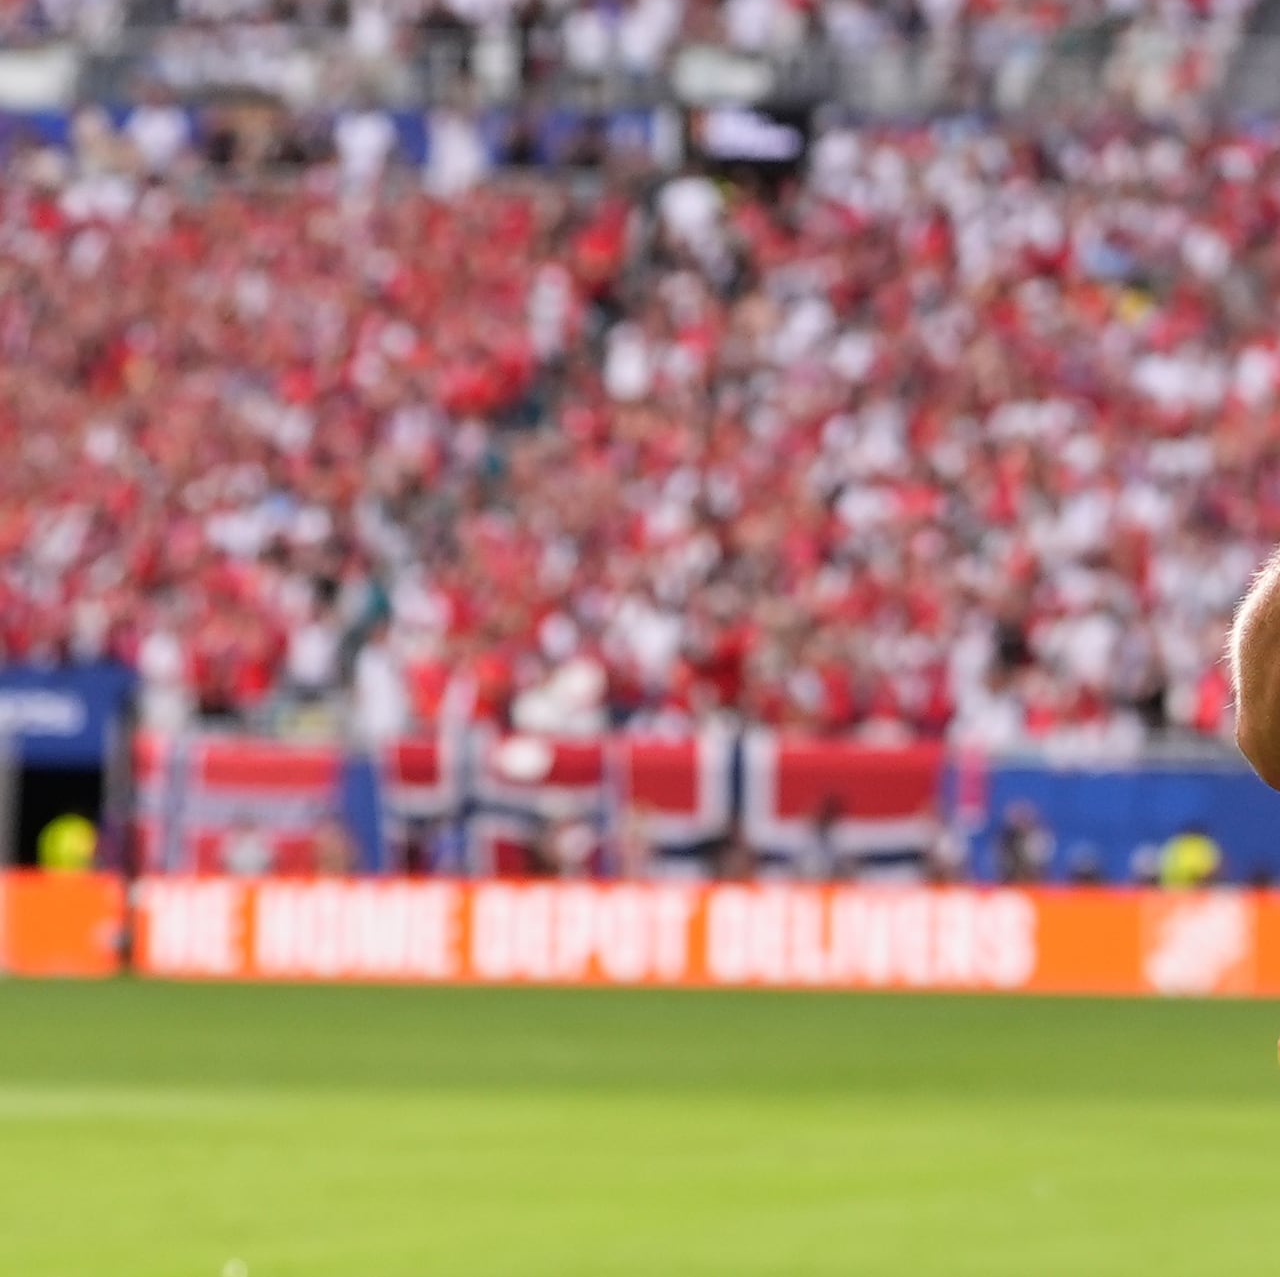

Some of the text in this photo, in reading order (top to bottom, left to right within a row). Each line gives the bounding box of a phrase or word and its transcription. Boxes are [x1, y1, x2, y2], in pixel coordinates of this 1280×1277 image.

[254, 880, 456, 978] HOME
[471, 883, 699, 983] DEPOT
[706, 886, 1038, 989] DELIVERS
